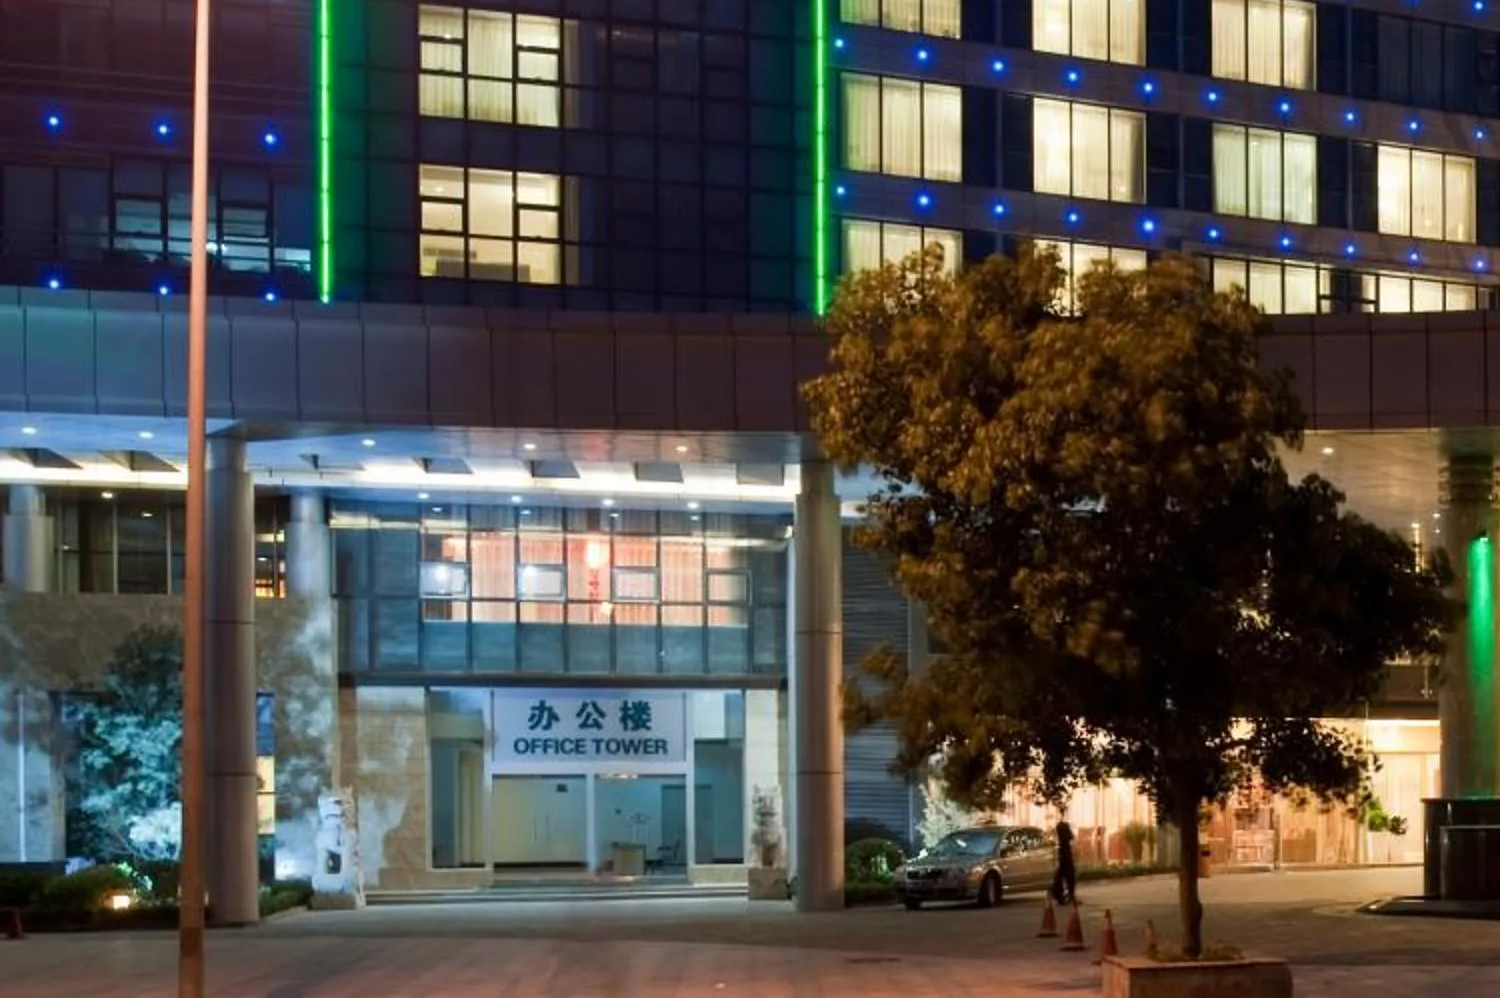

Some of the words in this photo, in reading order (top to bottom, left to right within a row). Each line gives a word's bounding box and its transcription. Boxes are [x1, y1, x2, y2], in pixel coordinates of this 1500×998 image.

[528, 700, 652, 731] 办公楼
[513, 737, 586, 754] OFFICE
[592, 737, 668, 754] TOWER
